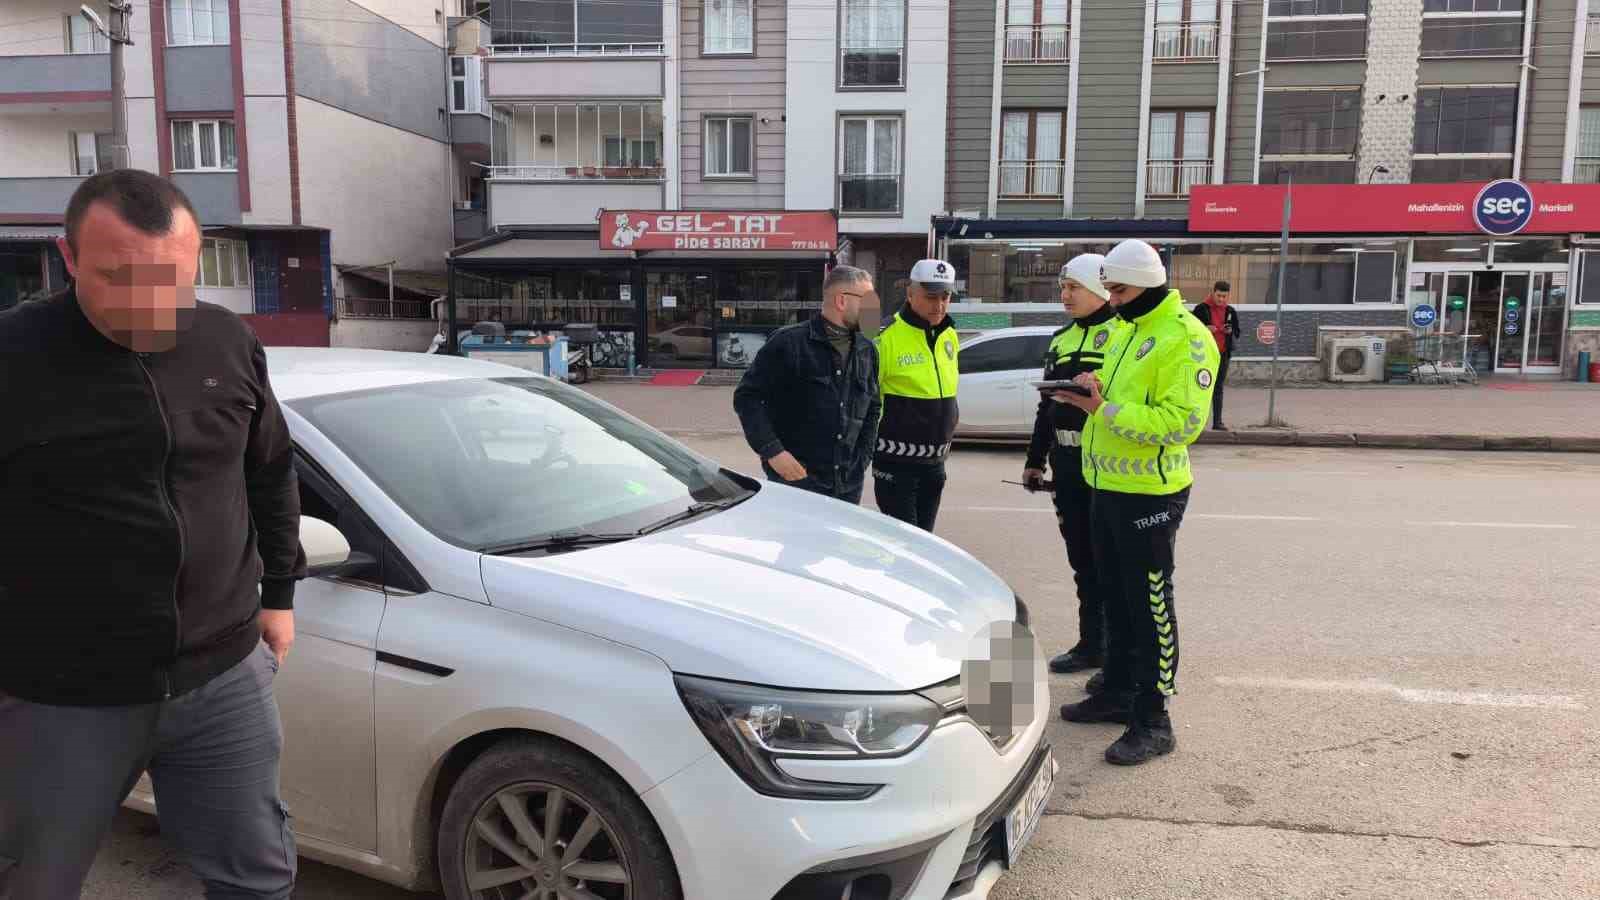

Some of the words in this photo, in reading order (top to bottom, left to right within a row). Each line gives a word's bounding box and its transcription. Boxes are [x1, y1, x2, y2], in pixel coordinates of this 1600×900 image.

[1408, 203, 1464, 213] Mahallenizin
[1482, 197, 1526, 216] seç
[656, 214, 783, 233] GEL-TAT
